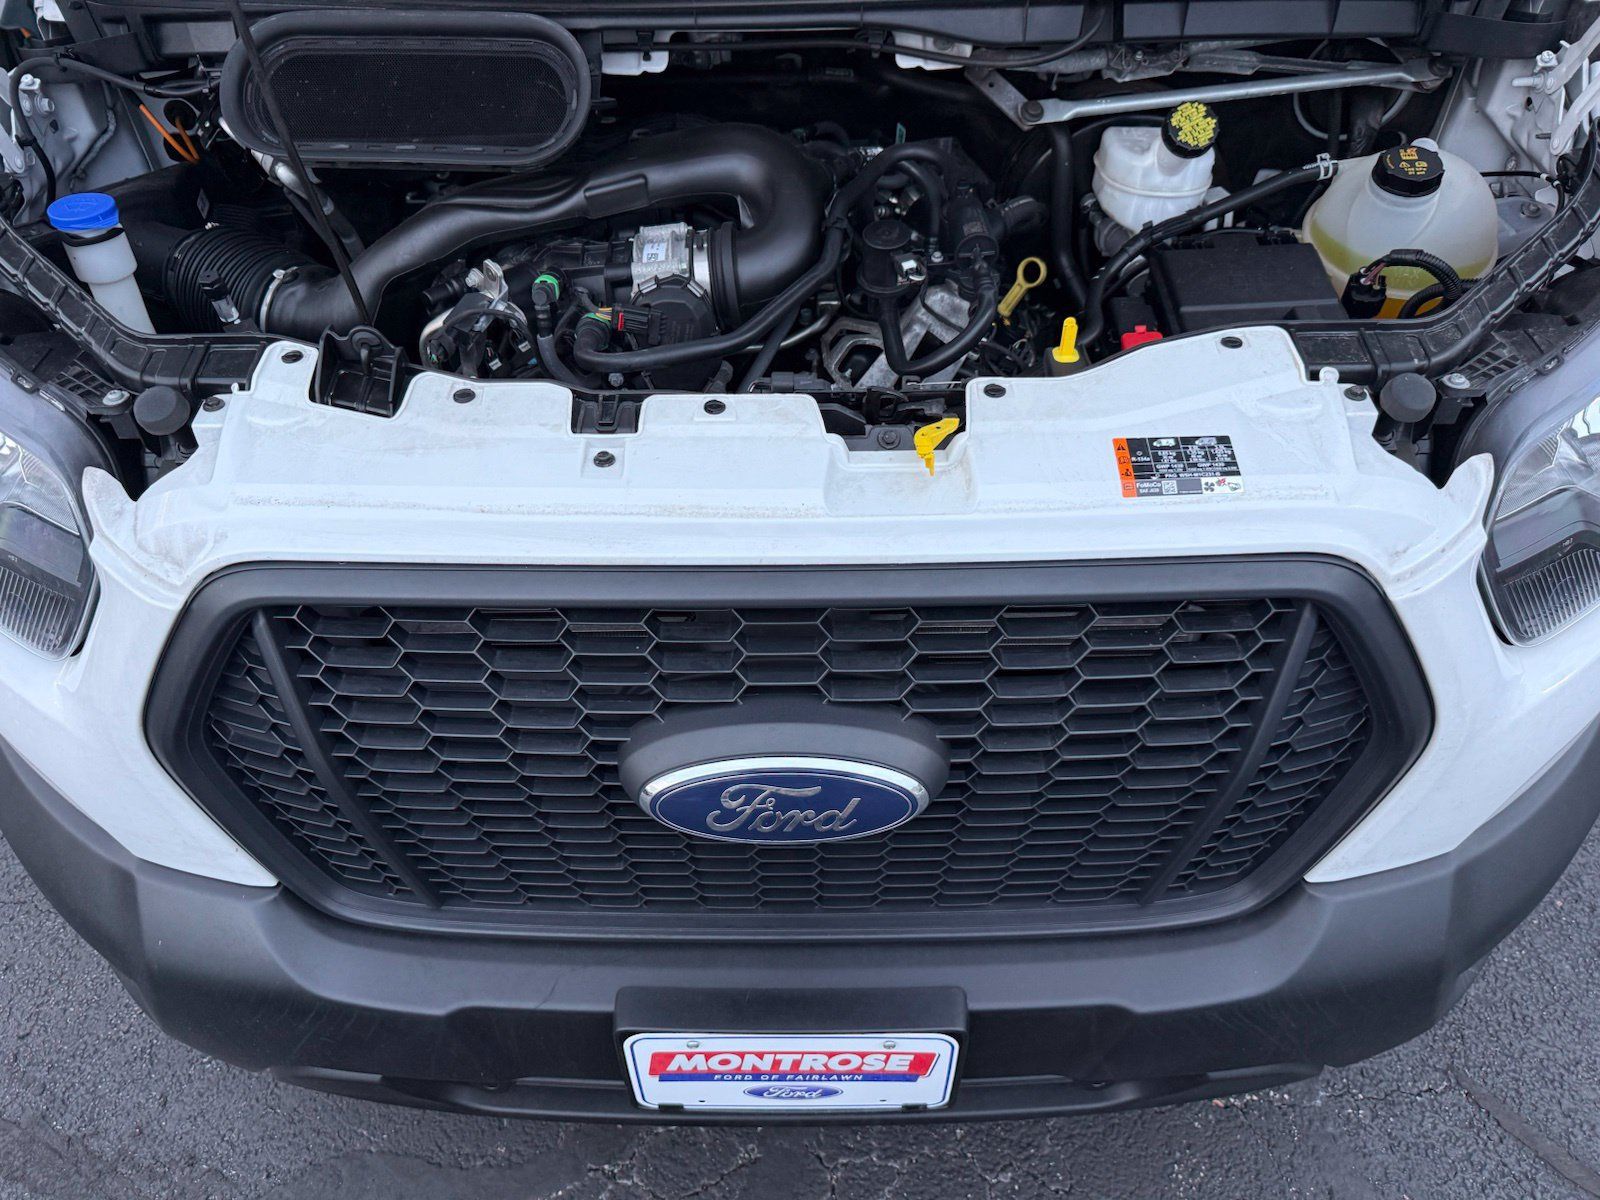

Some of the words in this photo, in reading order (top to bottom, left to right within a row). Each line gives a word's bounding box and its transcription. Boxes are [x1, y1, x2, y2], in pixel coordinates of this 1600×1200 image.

[705, 783, 861, 832] Ford
[667, 1053, 915, 1073] MONTROSE
[762, 1083, 823, 1099] Ford
